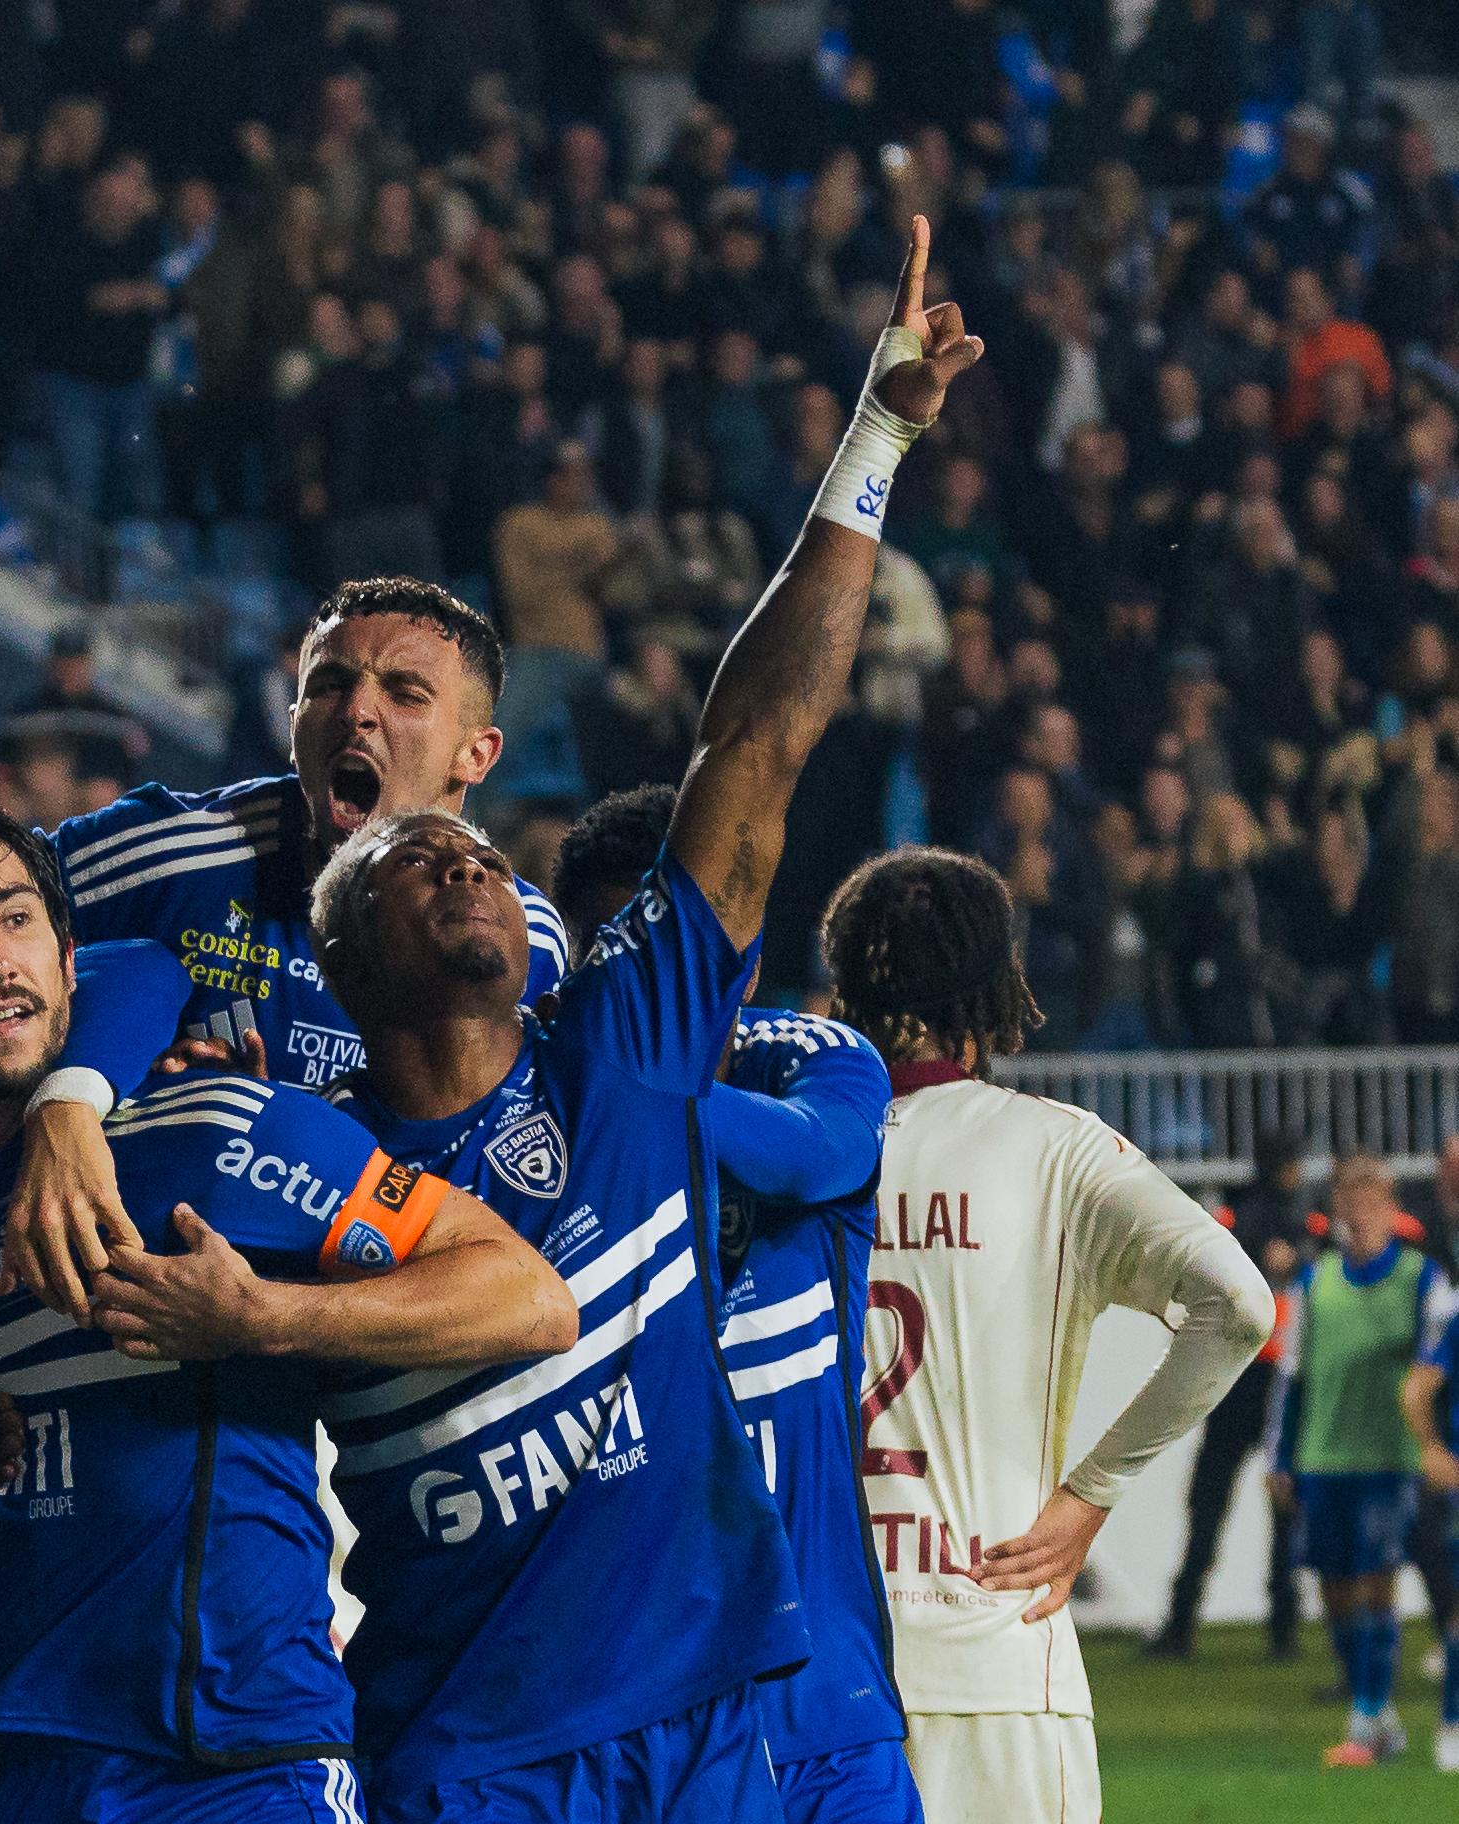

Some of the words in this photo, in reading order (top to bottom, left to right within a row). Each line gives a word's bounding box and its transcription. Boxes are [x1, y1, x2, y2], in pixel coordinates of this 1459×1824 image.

[181, 928, 281, 969] corsica
[287, 1028, 368, 1069] L'OLIVIE
[496, 1142, 513, 1160] SC
[509, 1122, 547, 1152] BASTIA
[215, 1137, 349, 1226] actu
[558, 1203, 593, 1232] CORSICA
[572, 1213, 600, 1239] CORSE
[874, 1191, 982, 1251] LLAL
[597, 1443, 649, 1482] GROUPE
[28, 1495, 76, 1520] GROUPE
